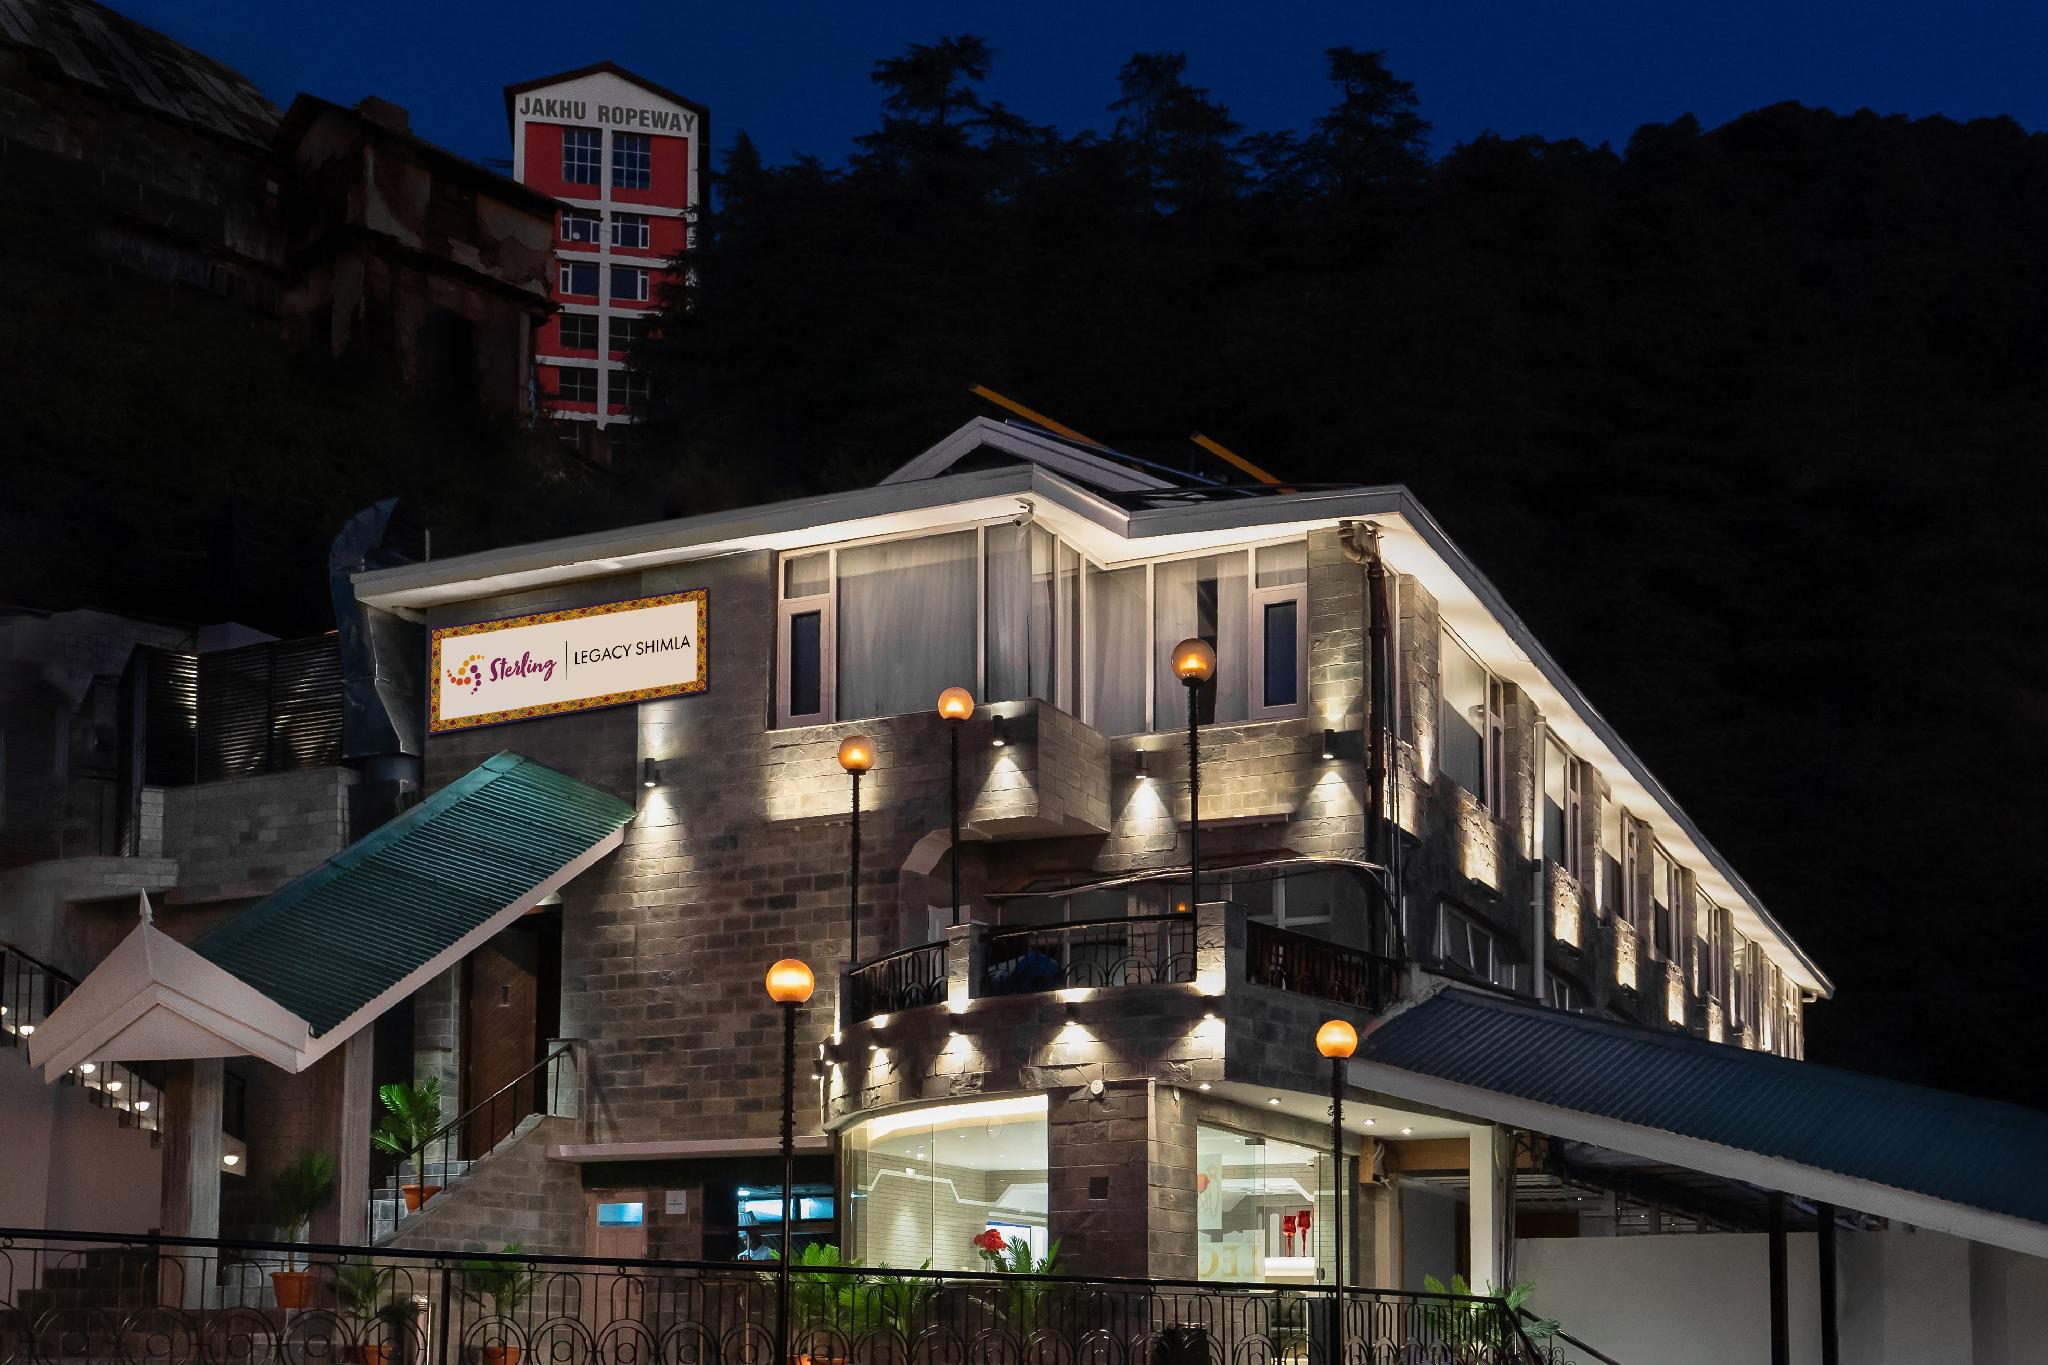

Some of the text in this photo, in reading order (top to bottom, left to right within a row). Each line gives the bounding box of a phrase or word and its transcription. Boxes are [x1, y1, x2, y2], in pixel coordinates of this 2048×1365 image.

[520, 97, 696, 133] JAKHU ROPEWAY
[490, 635, 691, 681] Sterling LEGACY SHIMLA
